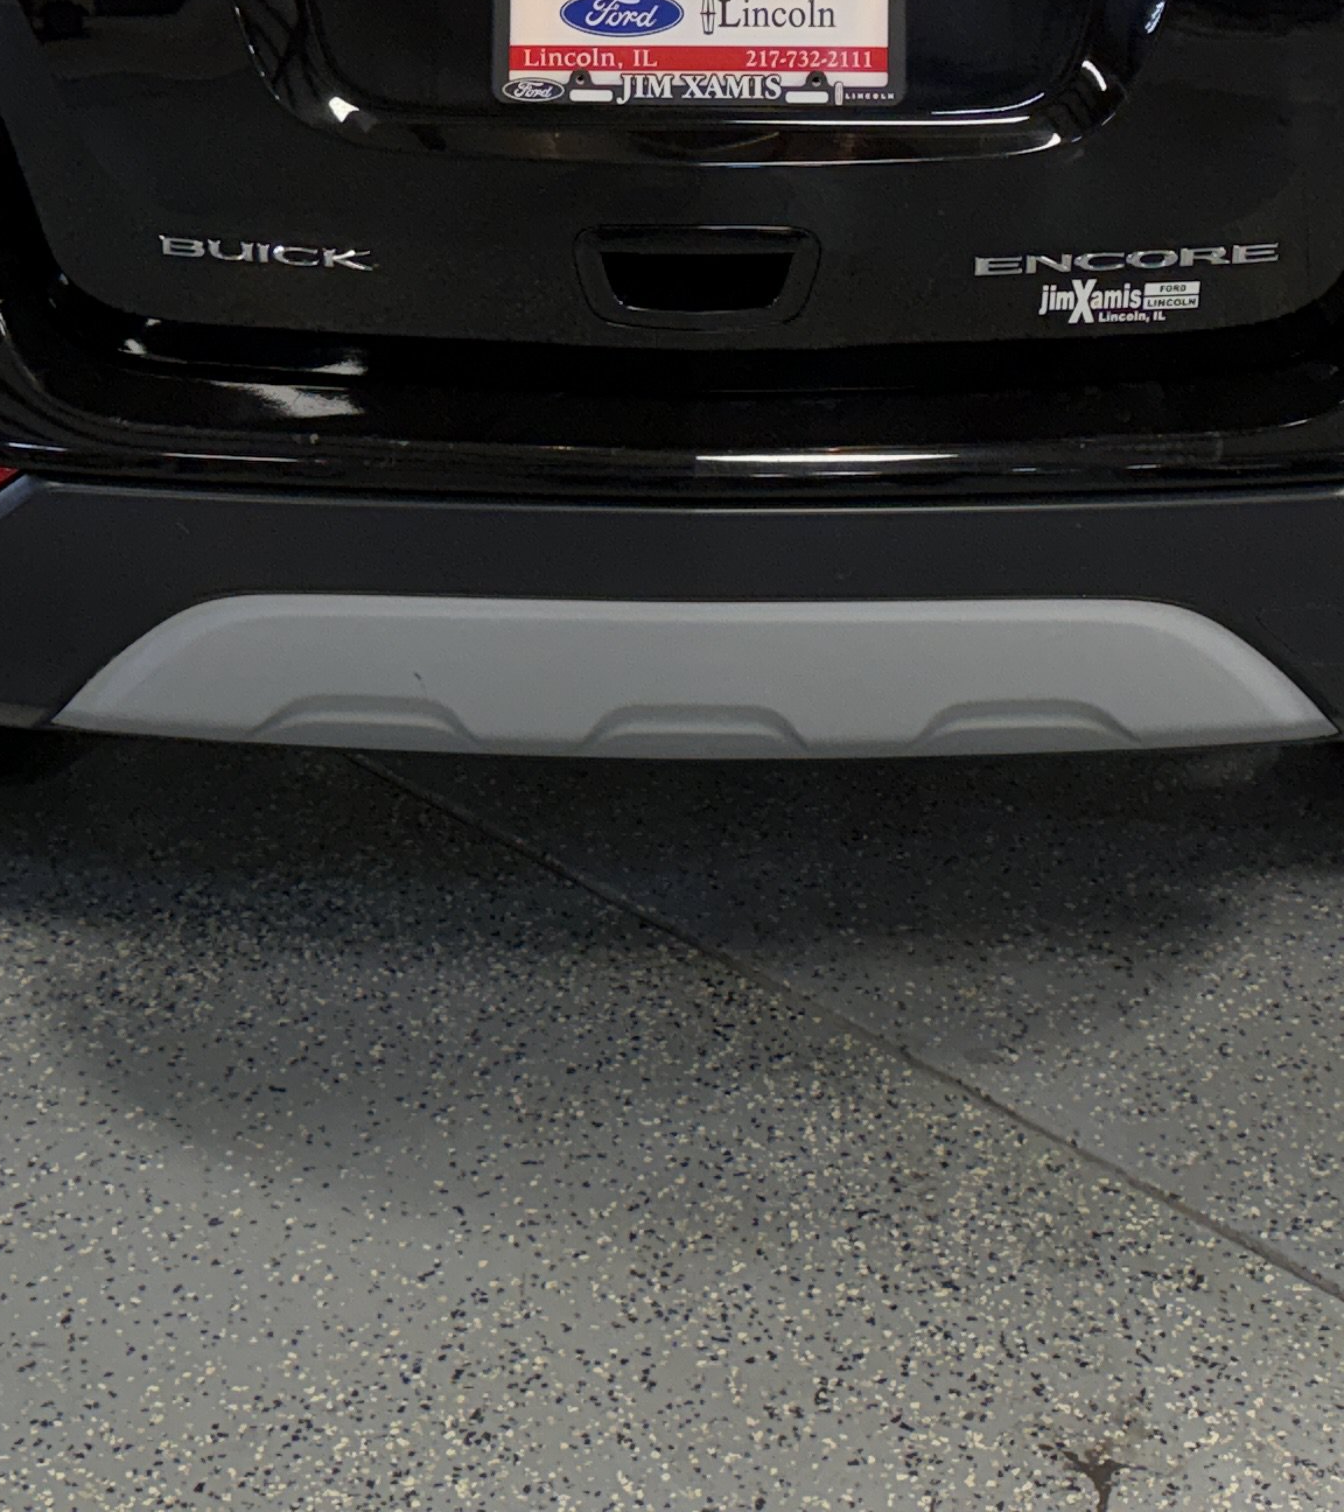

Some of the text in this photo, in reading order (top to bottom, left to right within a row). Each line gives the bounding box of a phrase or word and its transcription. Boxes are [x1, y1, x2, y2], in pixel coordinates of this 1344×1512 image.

[524, 47, 658, 70] Lincoln, IL
[745, 50, 873, 69] 217-732-2111
[513, 81, 555, 100] Ford
[617, 73, 782, 105] JIM XAMIS
[844, 92, 896, 100] LINCOLN
[159, 234, 374, 272] BUICK
[974, 242, 1280, 277] ENCORE
[1159, 284, 1187, 294] FORD
[1146, 297, 1197, 308] LINCOLN
[1097, 310, 1166, 323] Lincoln, IL
